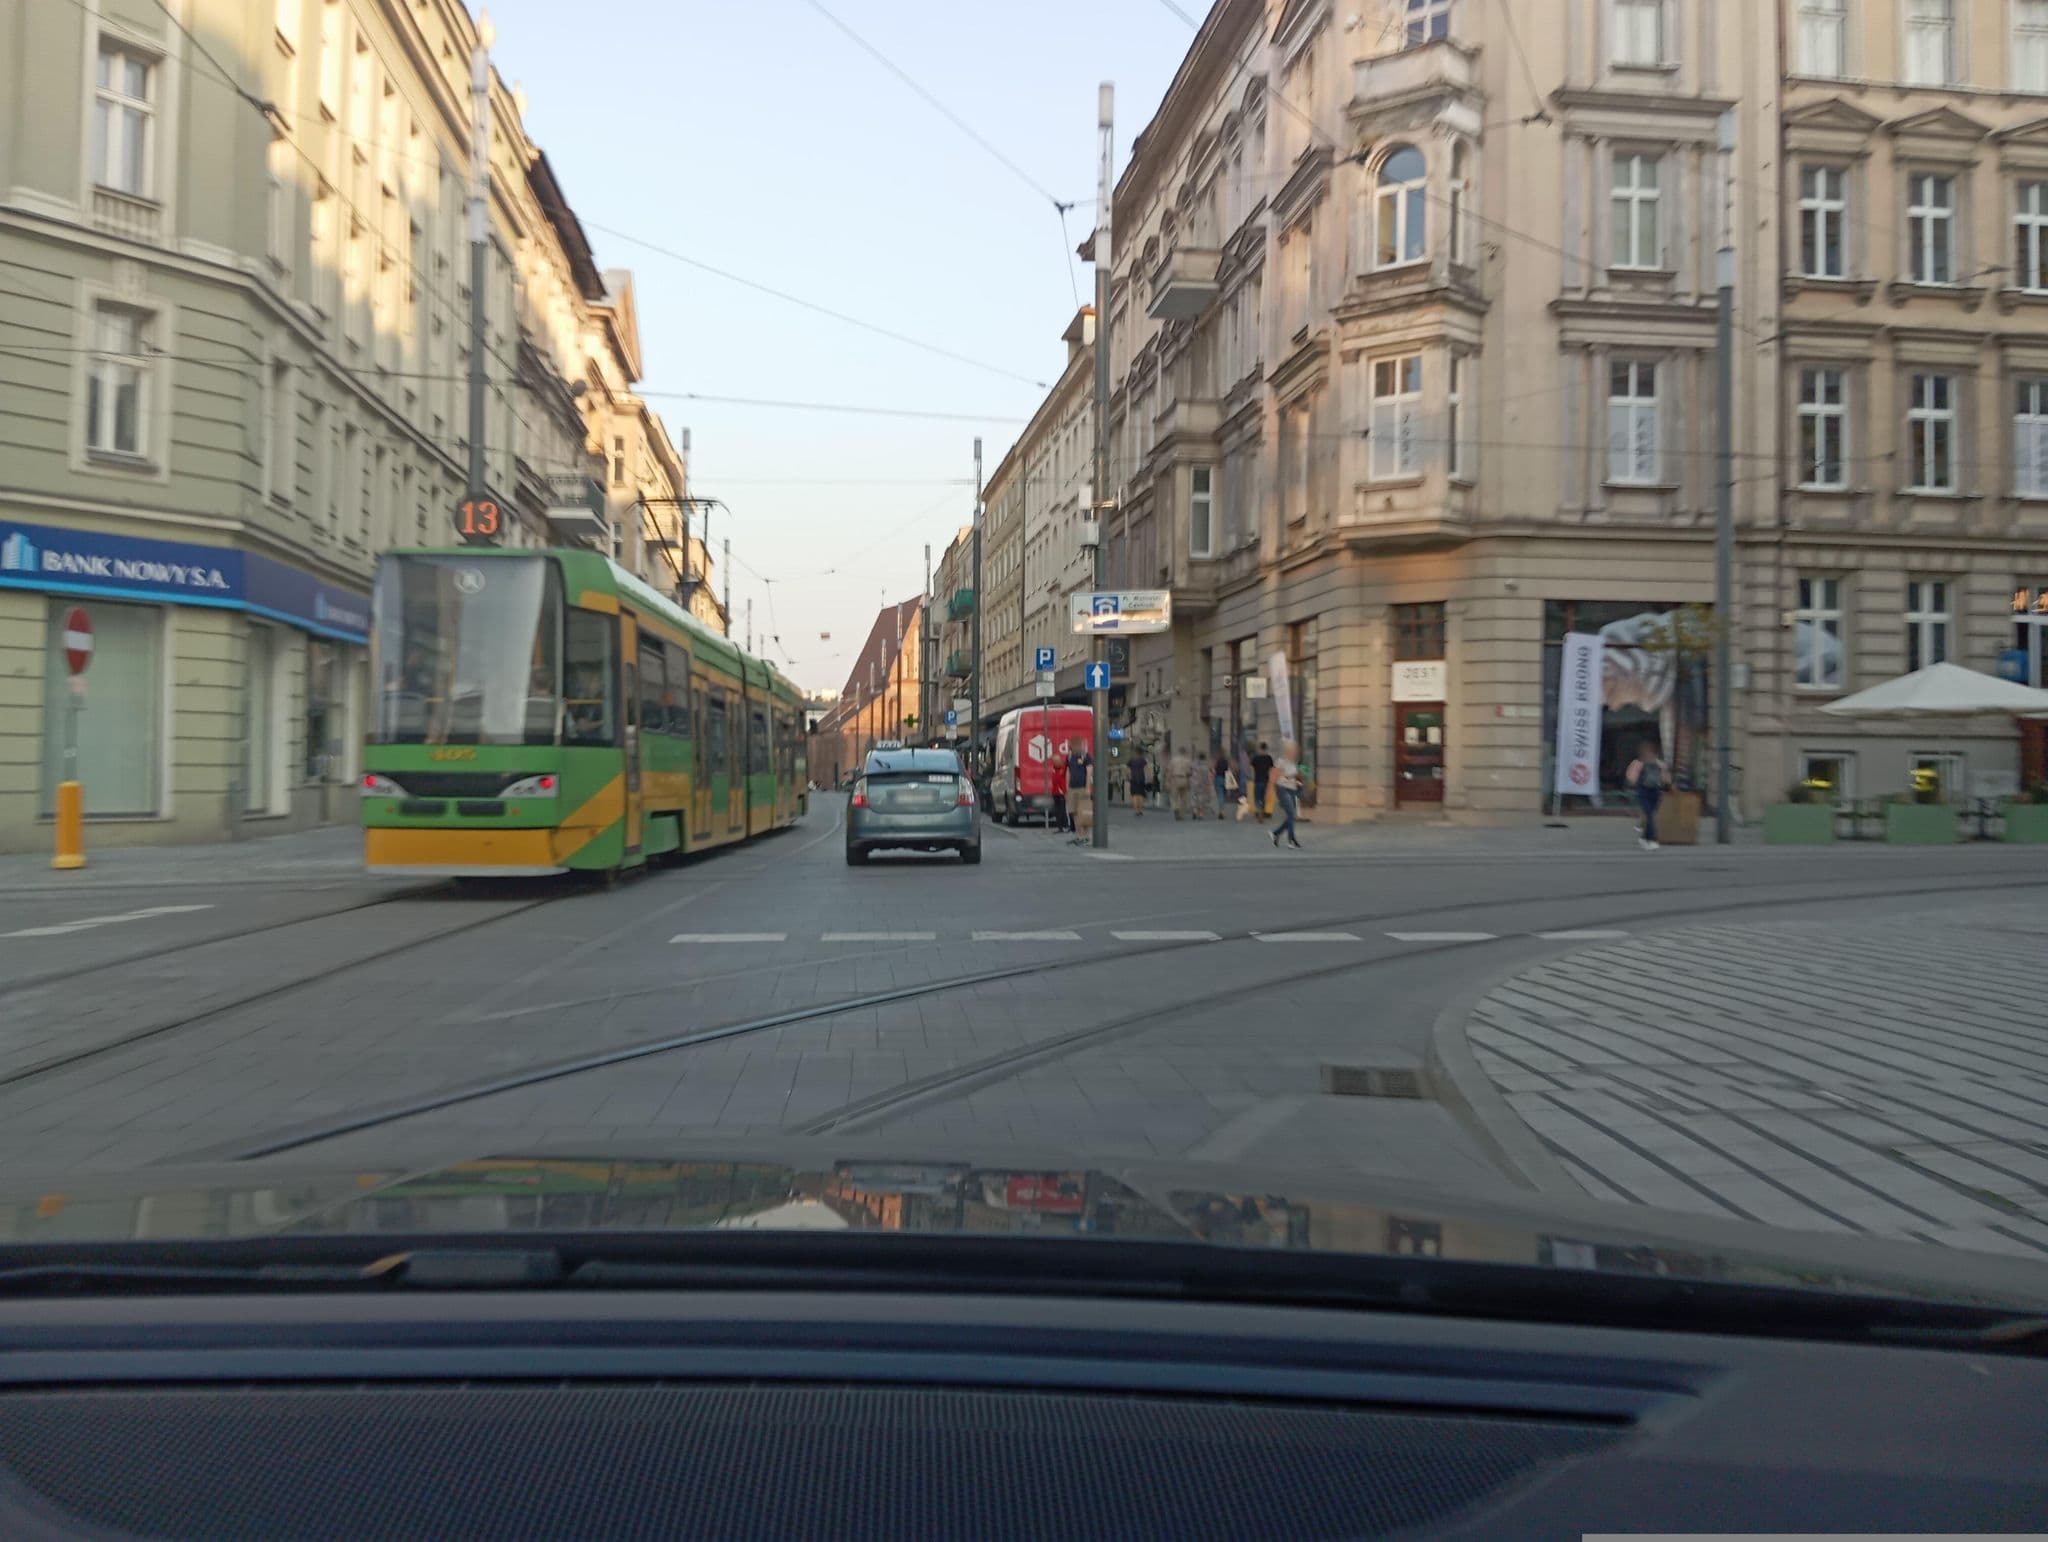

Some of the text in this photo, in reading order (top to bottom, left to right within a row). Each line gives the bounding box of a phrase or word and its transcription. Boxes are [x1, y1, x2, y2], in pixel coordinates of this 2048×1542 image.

[461, 501, 498, 534] 13
[42, 549, 112, 577] BANK
[113, 558, 191, 584] NOWY
[1574, 645, 1593, 758] SWISS KRONO
